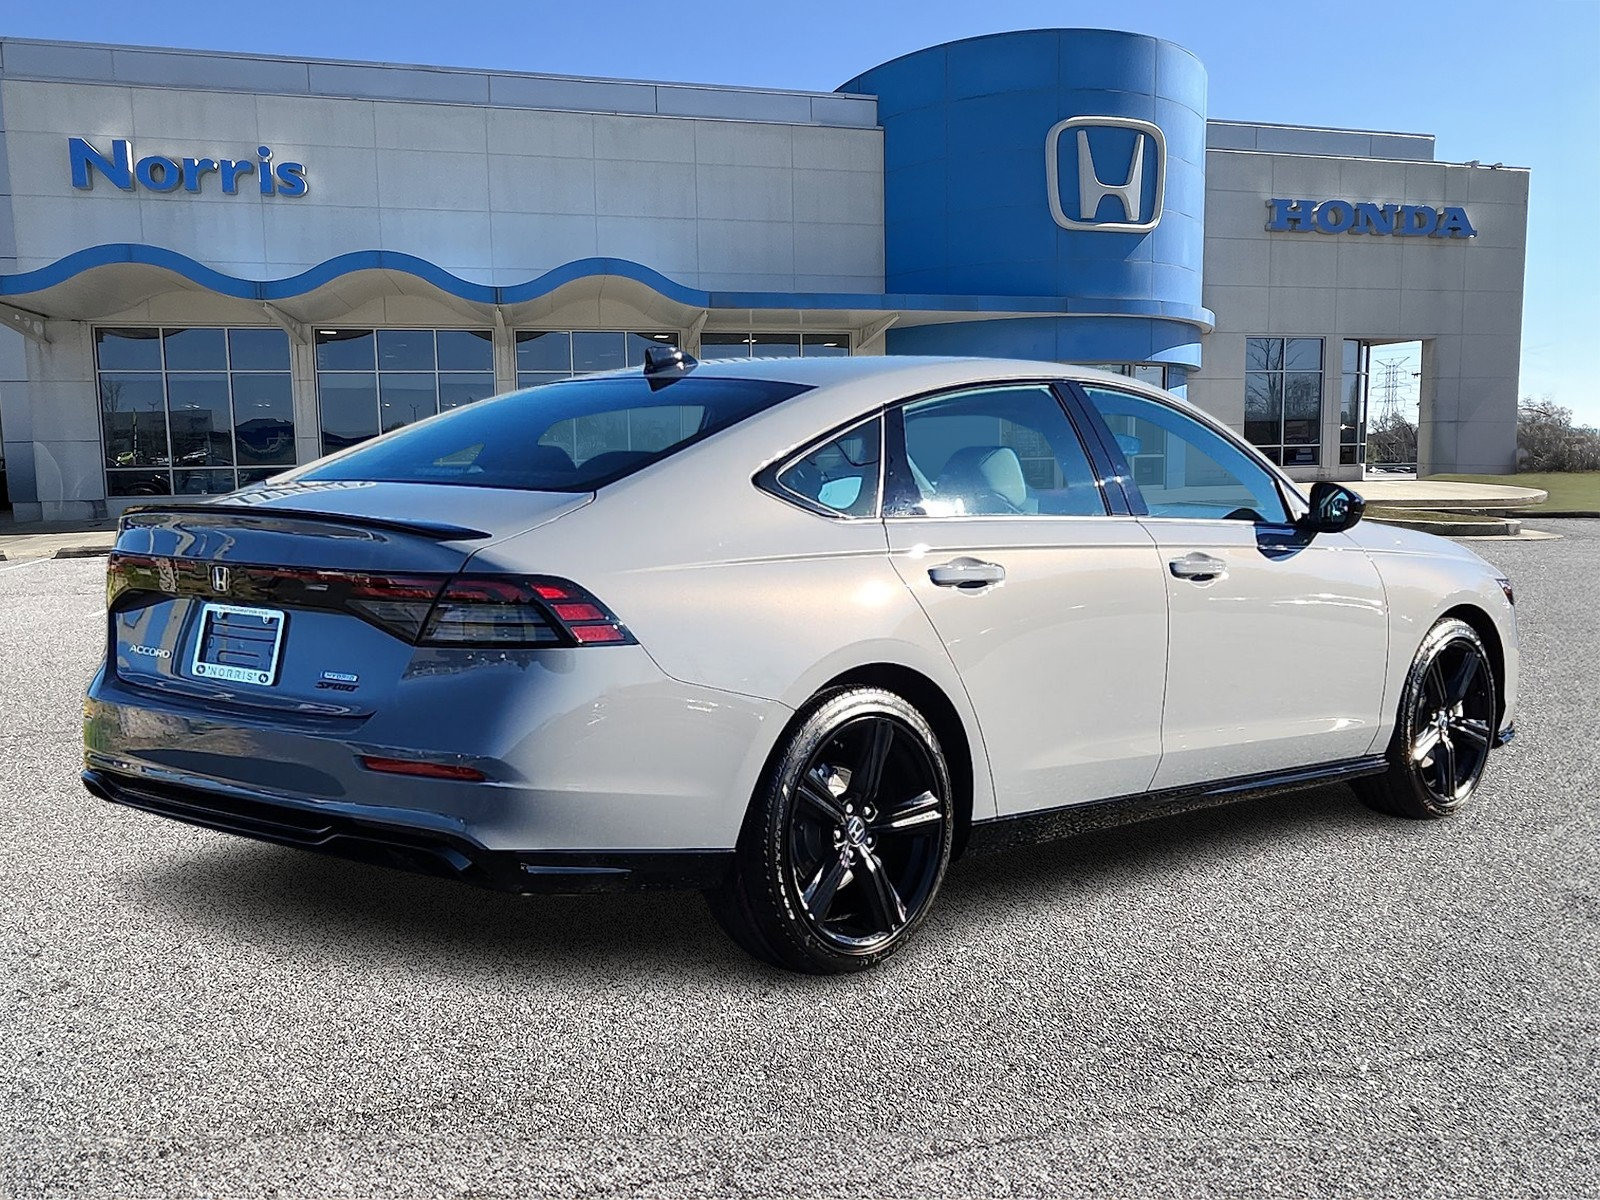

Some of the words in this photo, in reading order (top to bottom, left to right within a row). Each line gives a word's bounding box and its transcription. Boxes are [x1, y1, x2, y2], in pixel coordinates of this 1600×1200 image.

[68, 137, 308, 197] Norris
[1265, 198, 1478, 239] HONDA
[129, 644, 171, 659] ACCORD
